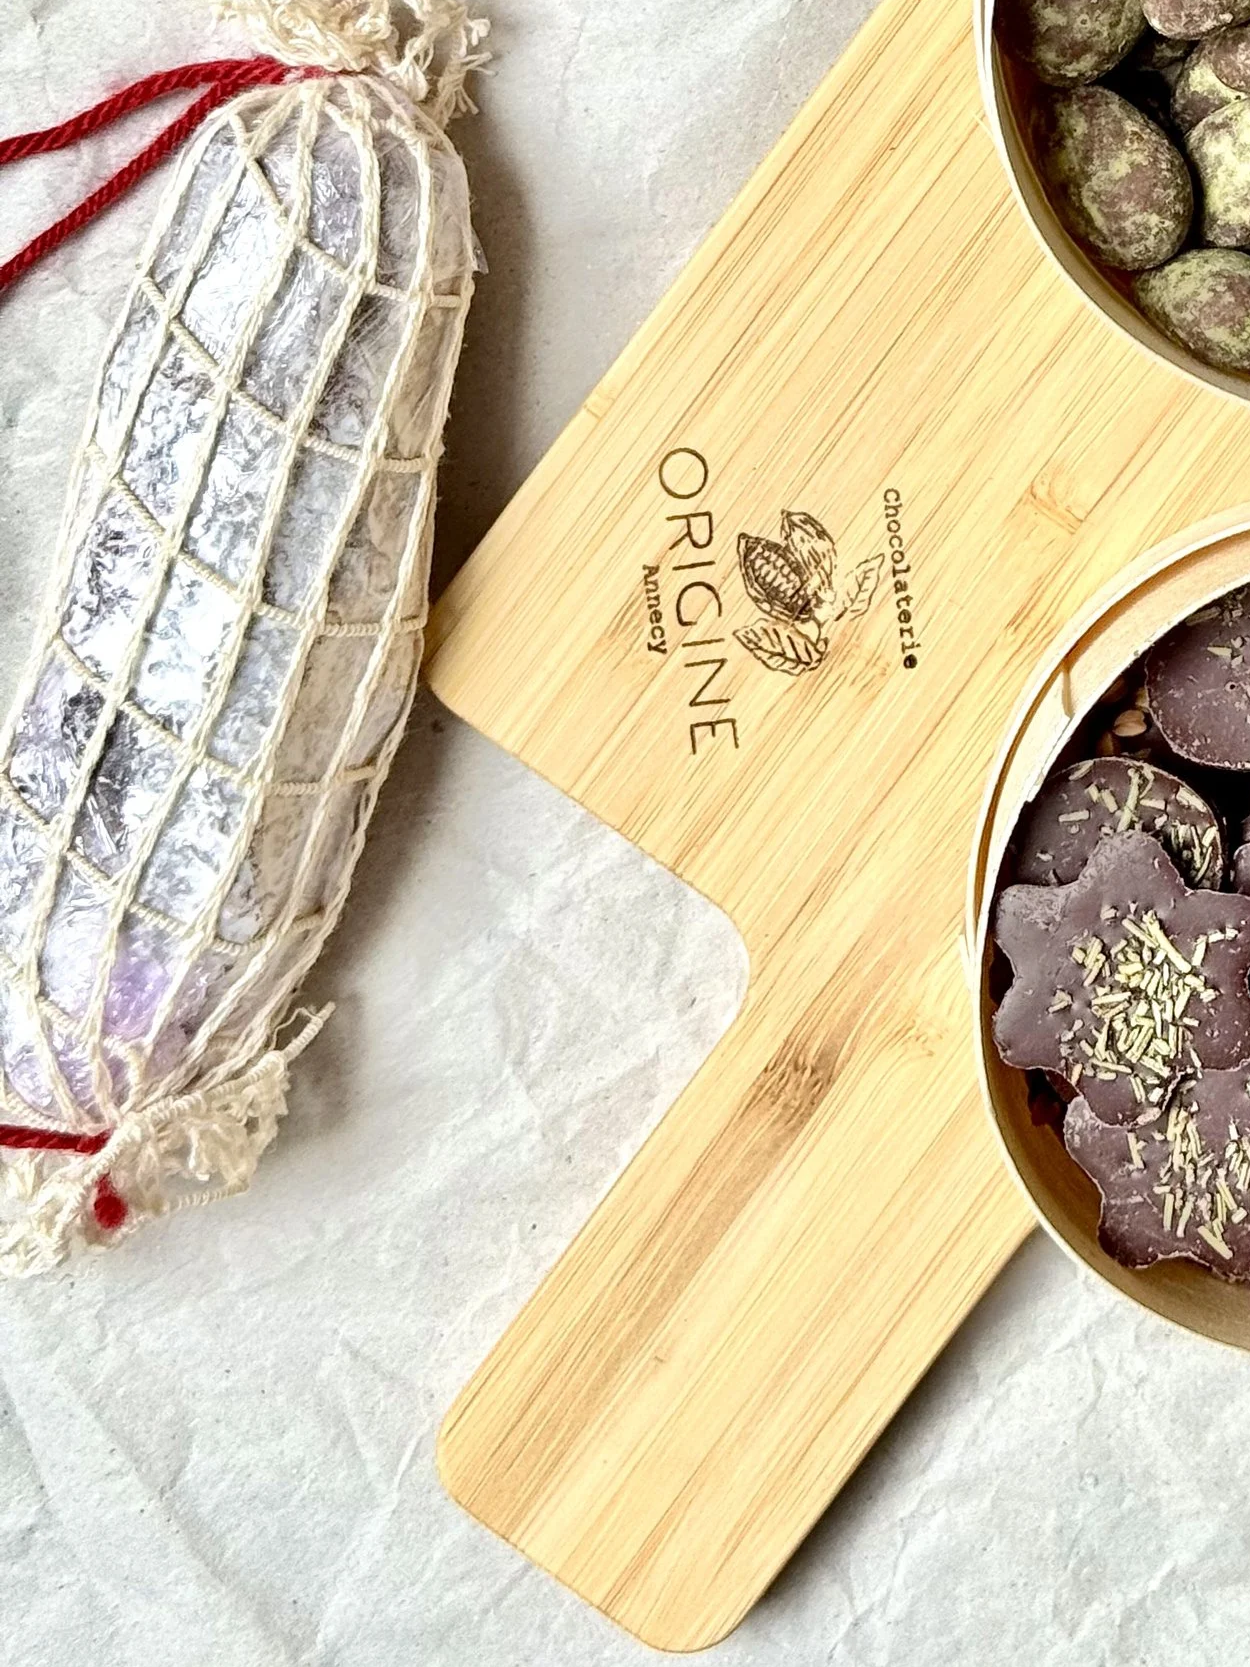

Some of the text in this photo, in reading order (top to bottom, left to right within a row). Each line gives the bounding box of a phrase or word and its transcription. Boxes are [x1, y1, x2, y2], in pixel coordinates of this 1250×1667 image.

[642, 564, 668, 655] Annecy
[658, 447, 739, 755] ORIGINE
[883, 487, 921, 670] Chocolaterie
